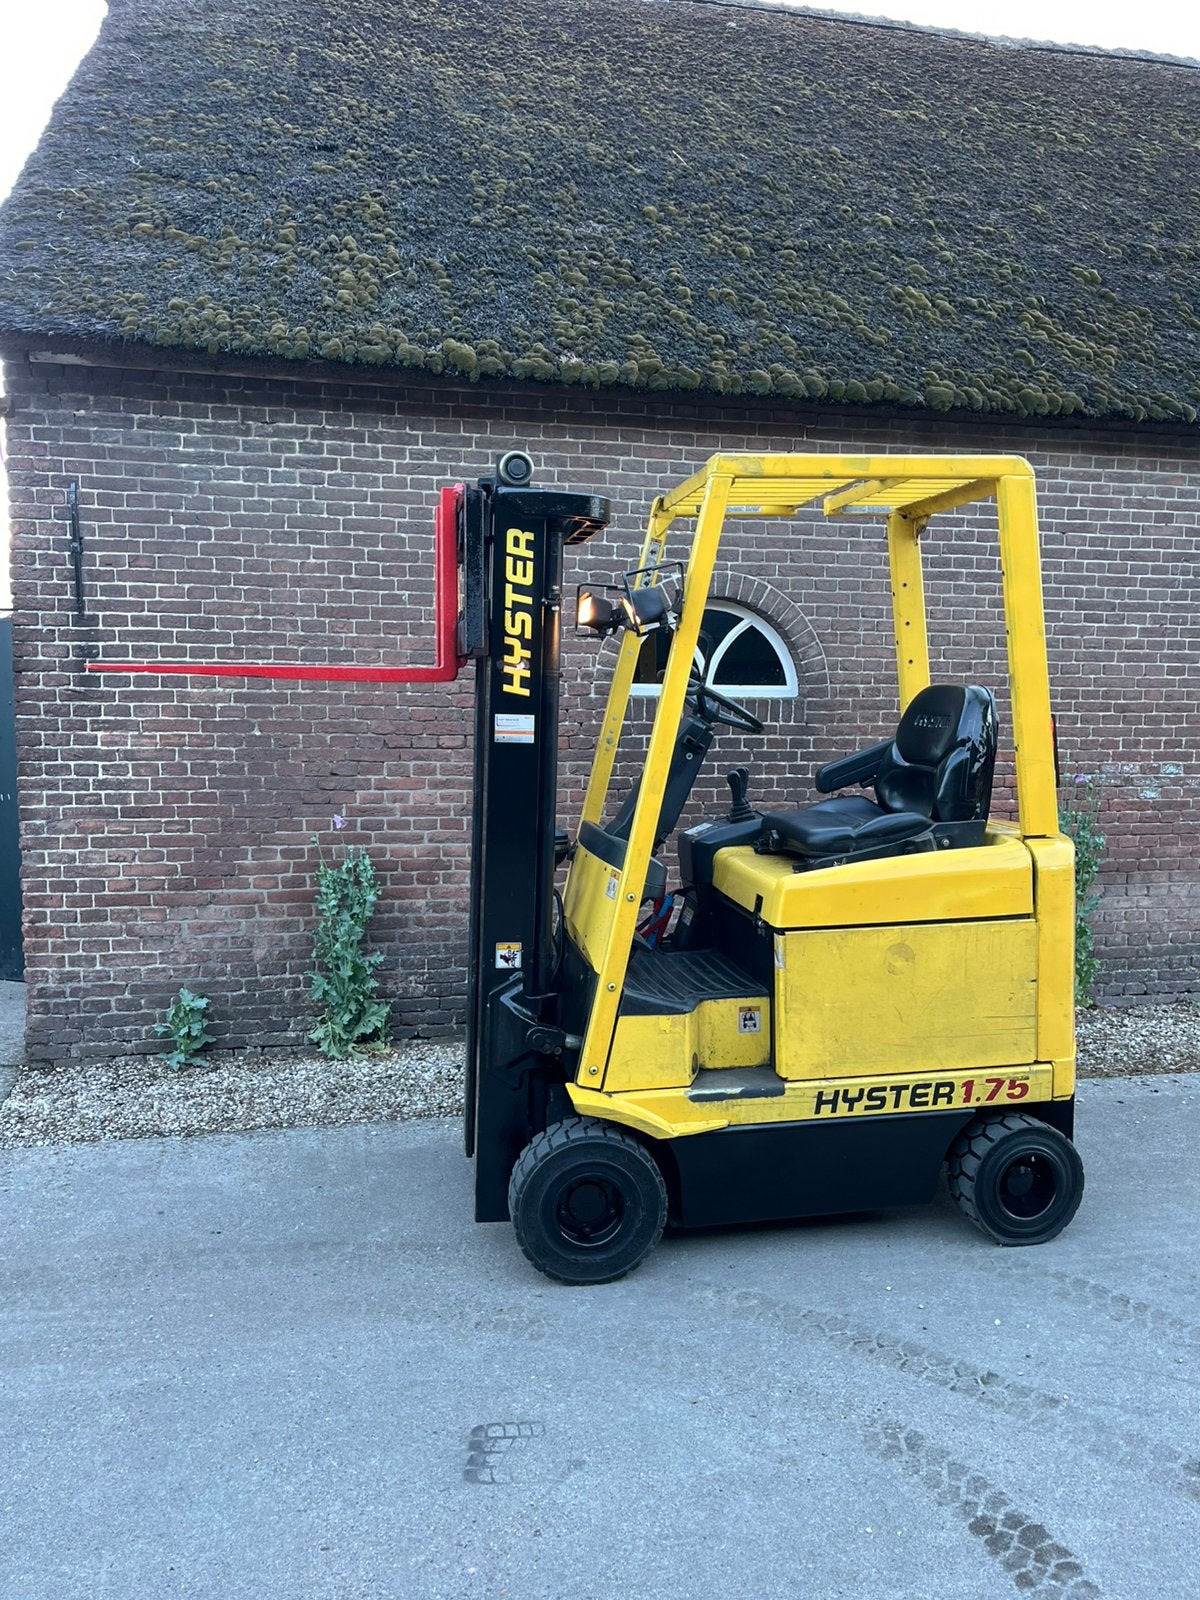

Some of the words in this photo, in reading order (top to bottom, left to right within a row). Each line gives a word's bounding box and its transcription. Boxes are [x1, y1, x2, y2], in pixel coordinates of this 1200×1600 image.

[502, 528, 535, 697] HYSTER
[814, 1081, 956, 1115] HYSTER
[961, 1076, 1030, 1104] 1.75
